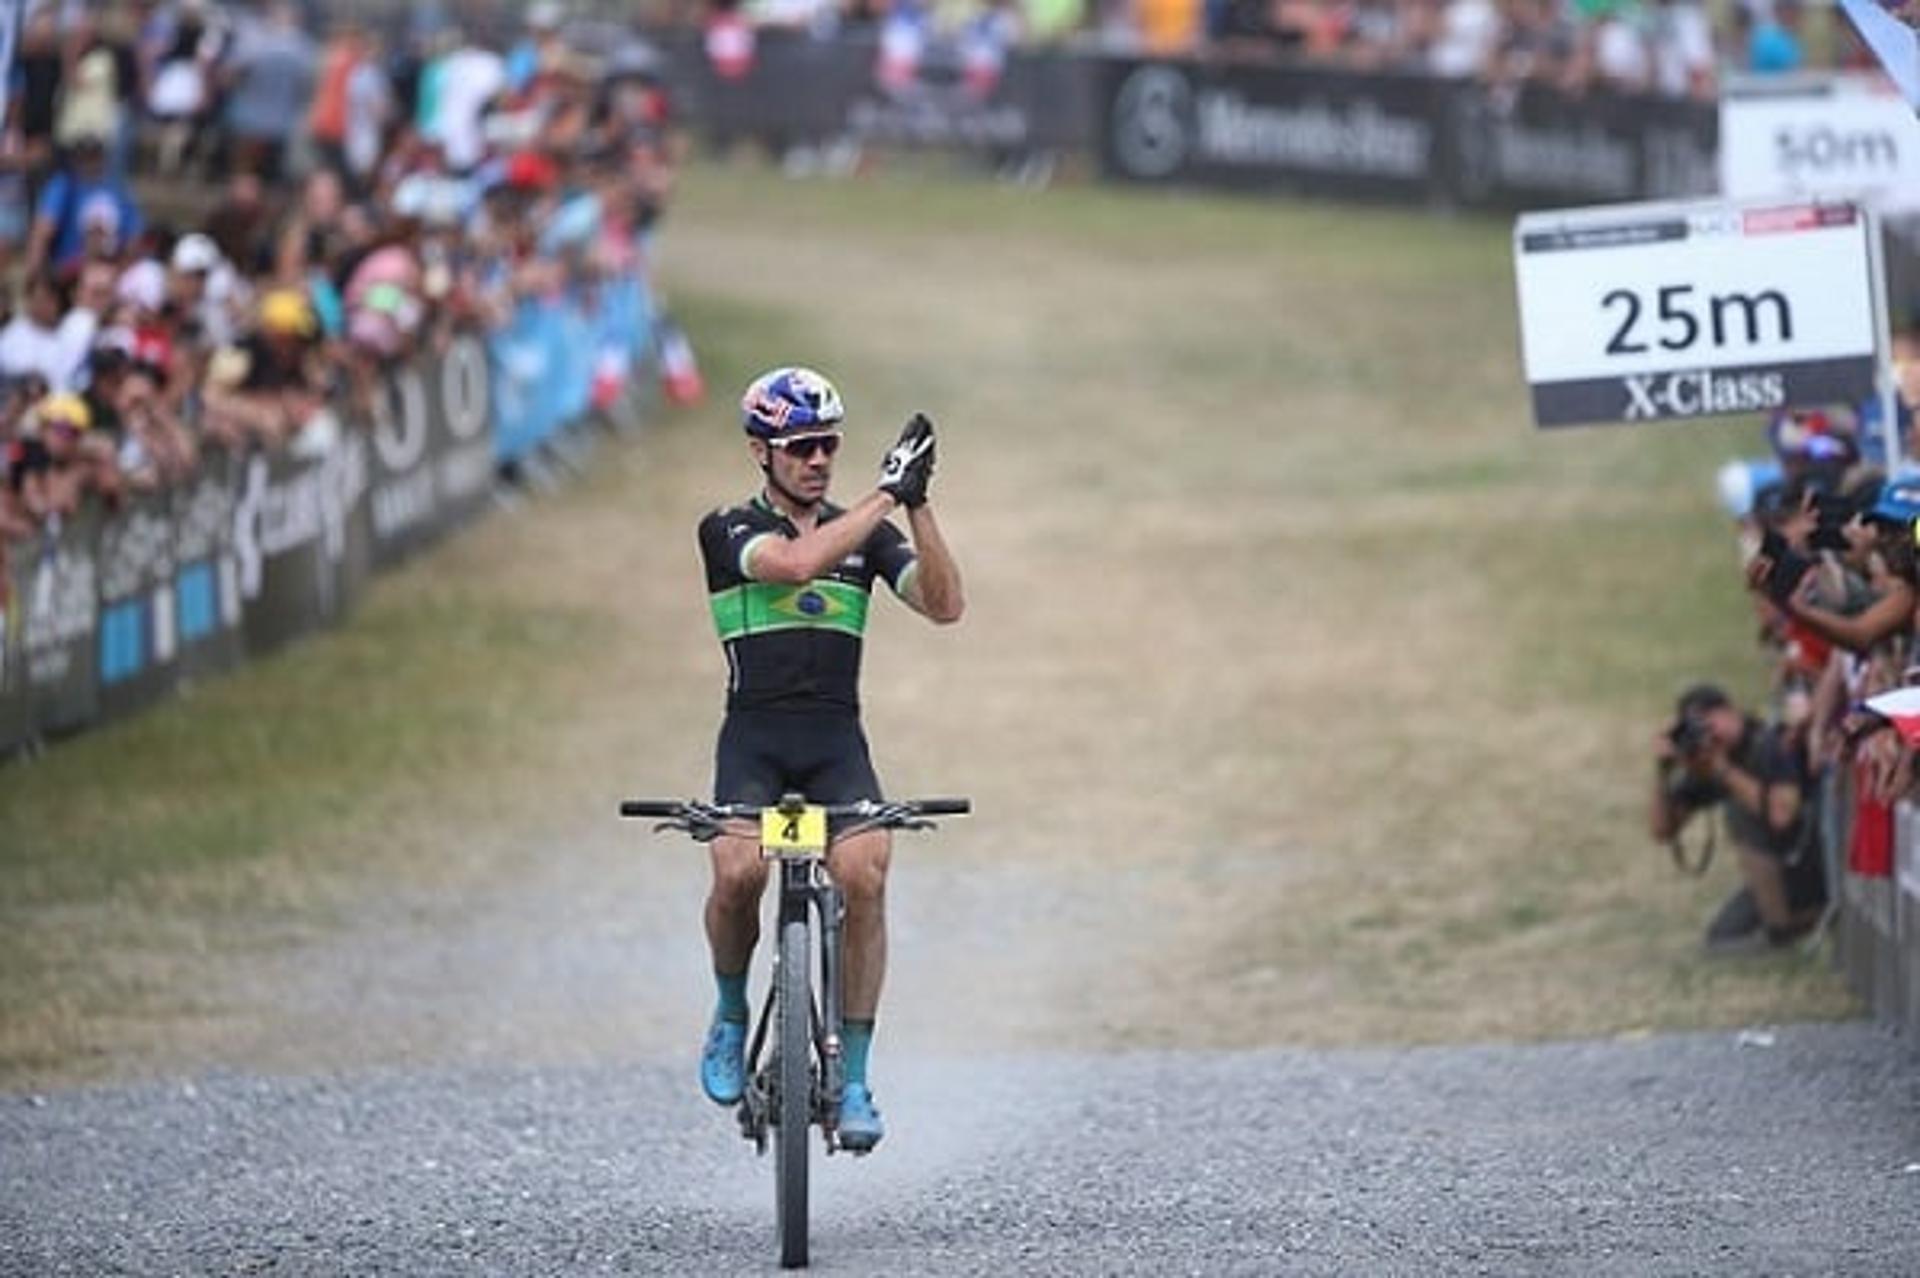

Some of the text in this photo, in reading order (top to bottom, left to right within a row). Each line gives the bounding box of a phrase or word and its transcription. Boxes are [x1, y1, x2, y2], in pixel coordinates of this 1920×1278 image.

[1775, 128, 1899, 170] 50m
[1602, 285, 1792, 356] 25m
[1624, 369, 1785, 420] X-Class
[781, 817, 799, 842] 4
